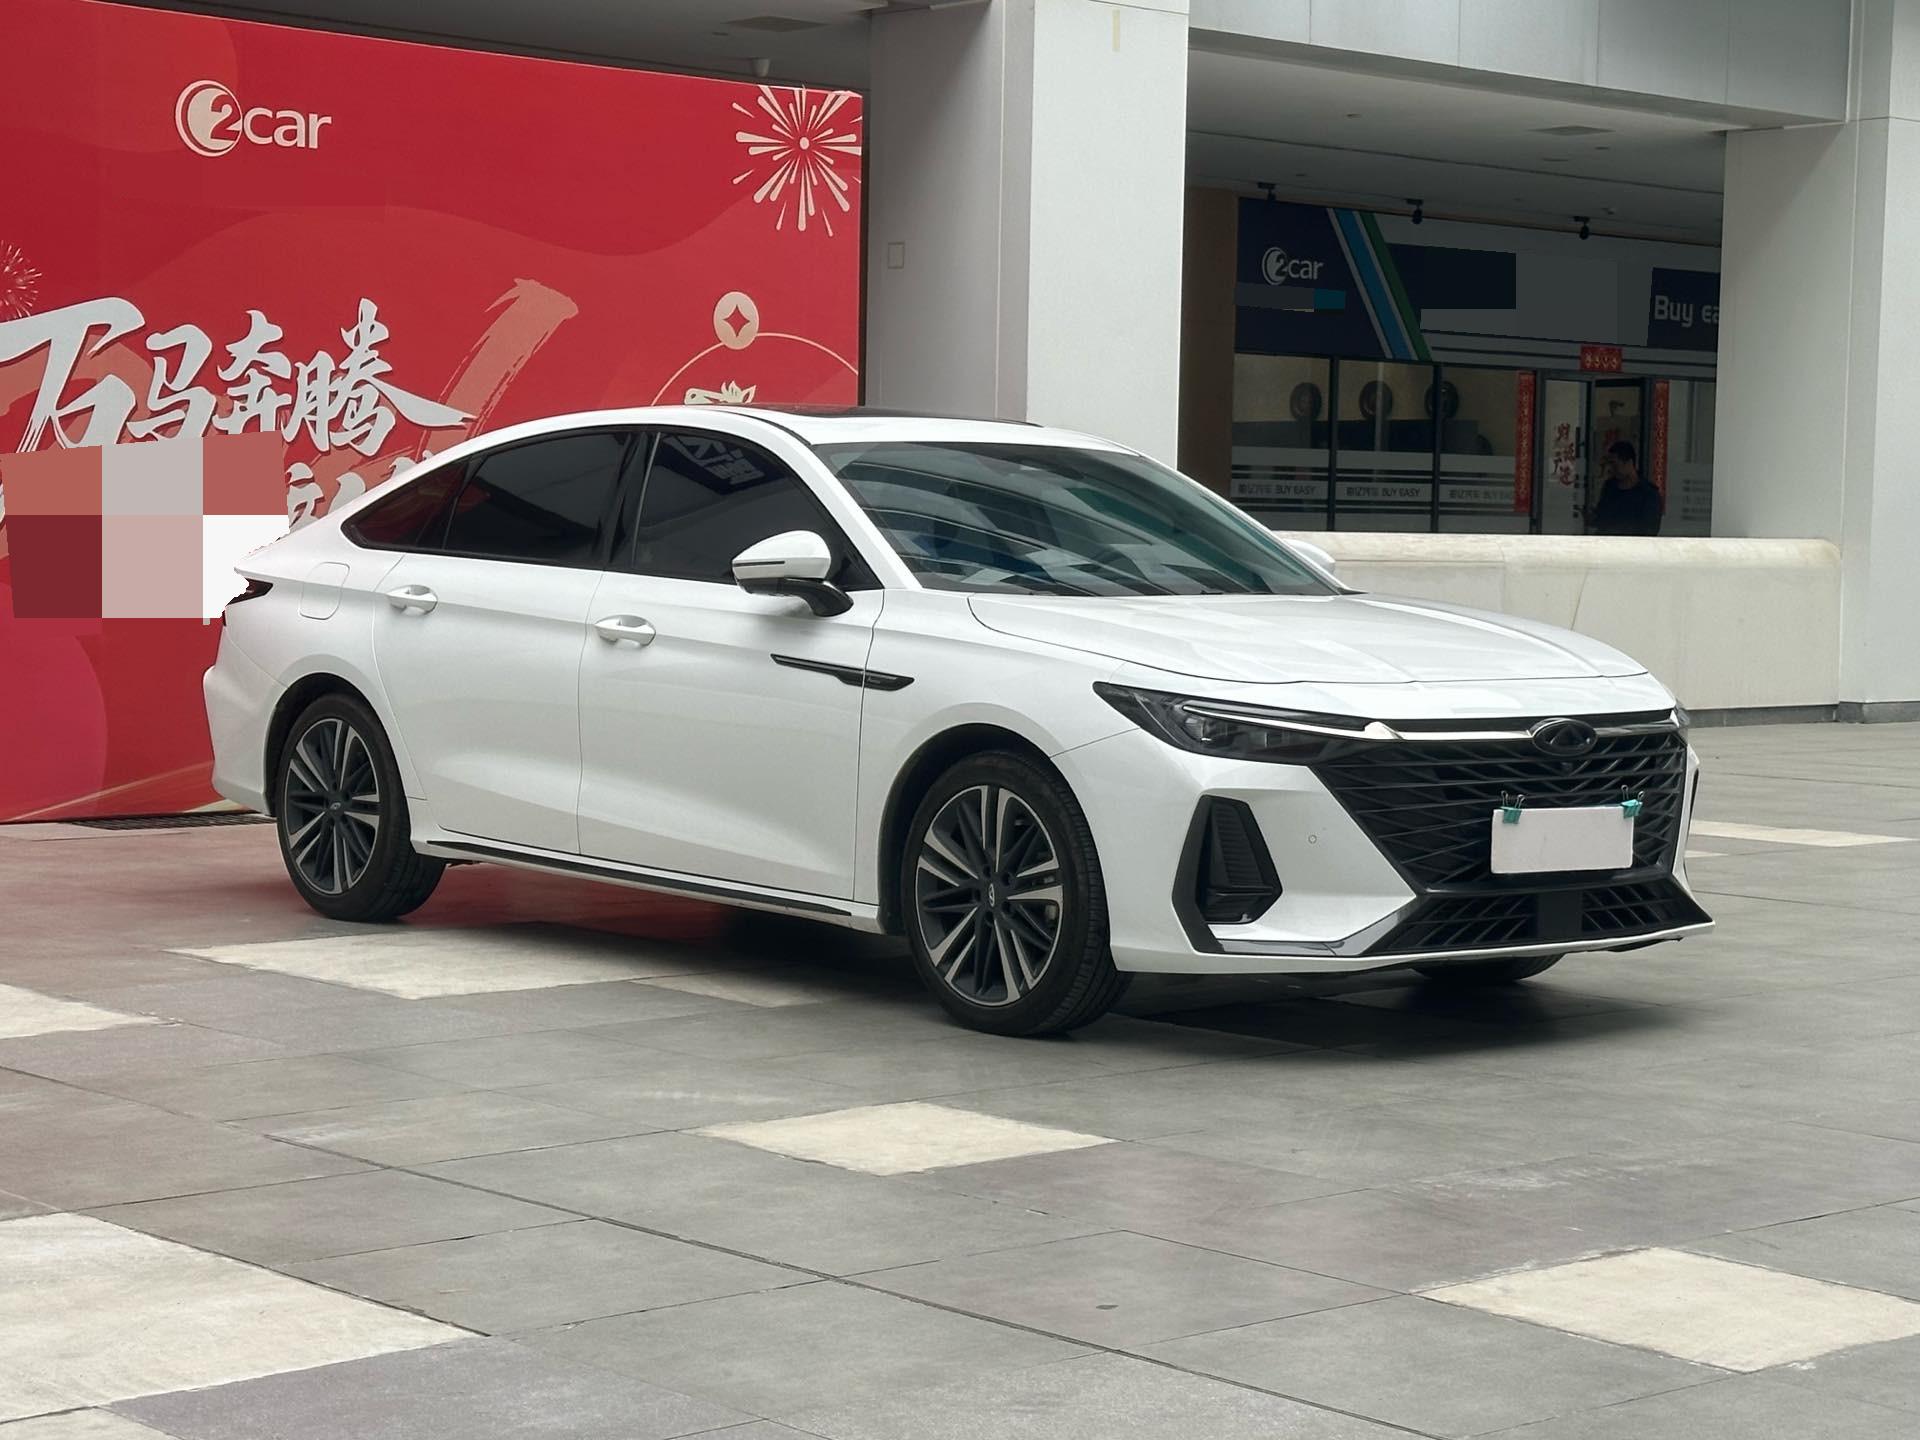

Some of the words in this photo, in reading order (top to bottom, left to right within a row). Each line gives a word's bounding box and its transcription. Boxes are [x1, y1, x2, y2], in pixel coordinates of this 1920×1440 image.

[1654, 294, 1694, 328] Buy
[1275, 484, 1291, 495] BUY
[1293, 484, 1317, 495] EASY
[1382, 487, 1397, 497] BUY
[1399, 487, 1421, 497] EASY
